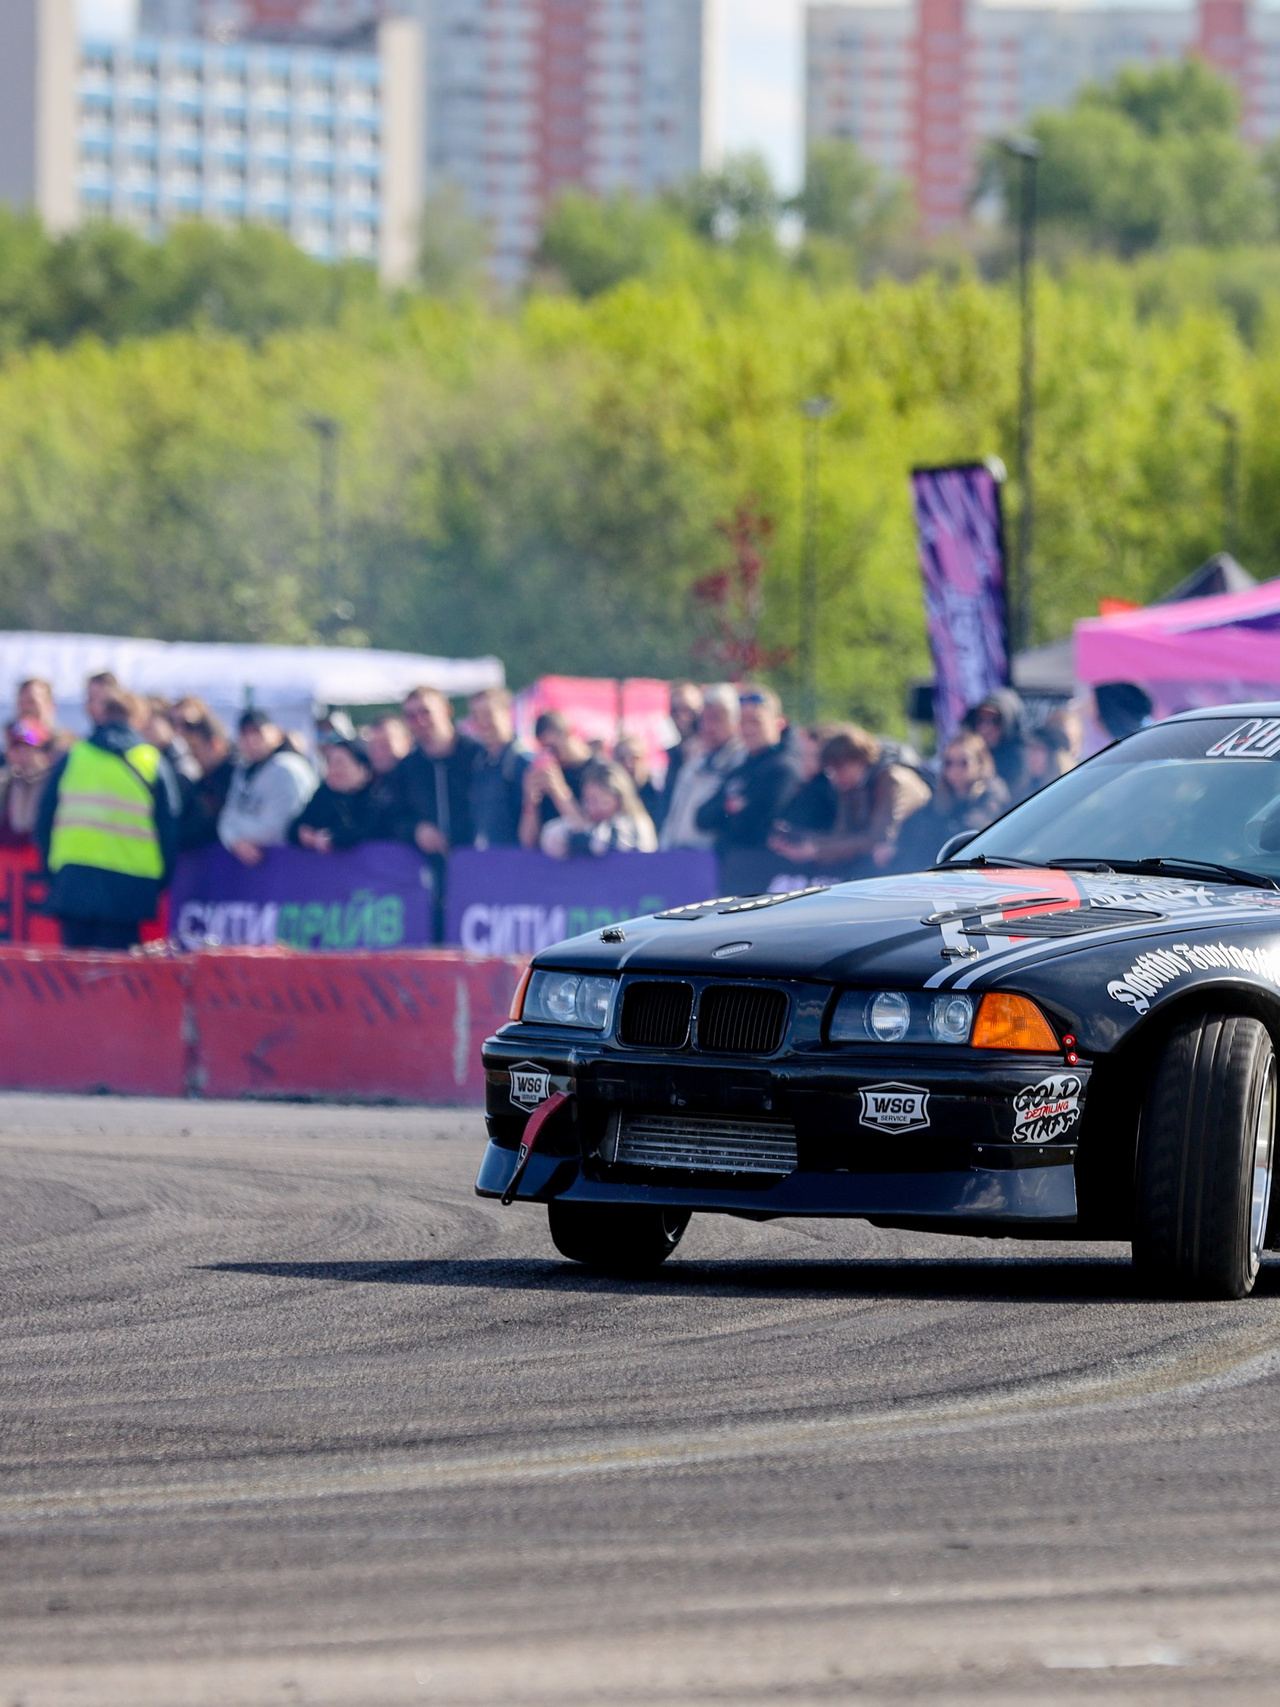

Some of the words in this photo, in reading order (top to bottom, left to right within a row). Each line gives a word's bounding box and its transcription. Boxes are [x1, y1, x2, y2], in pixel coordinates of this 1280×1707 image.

[517, 1076, 542, 1093] WSG
[1015, 1077, 1080, 1112] GOLD
[872, 1097, 916, 1114] WSG
[1024, 1100, 1069, 1120] DETAILING
